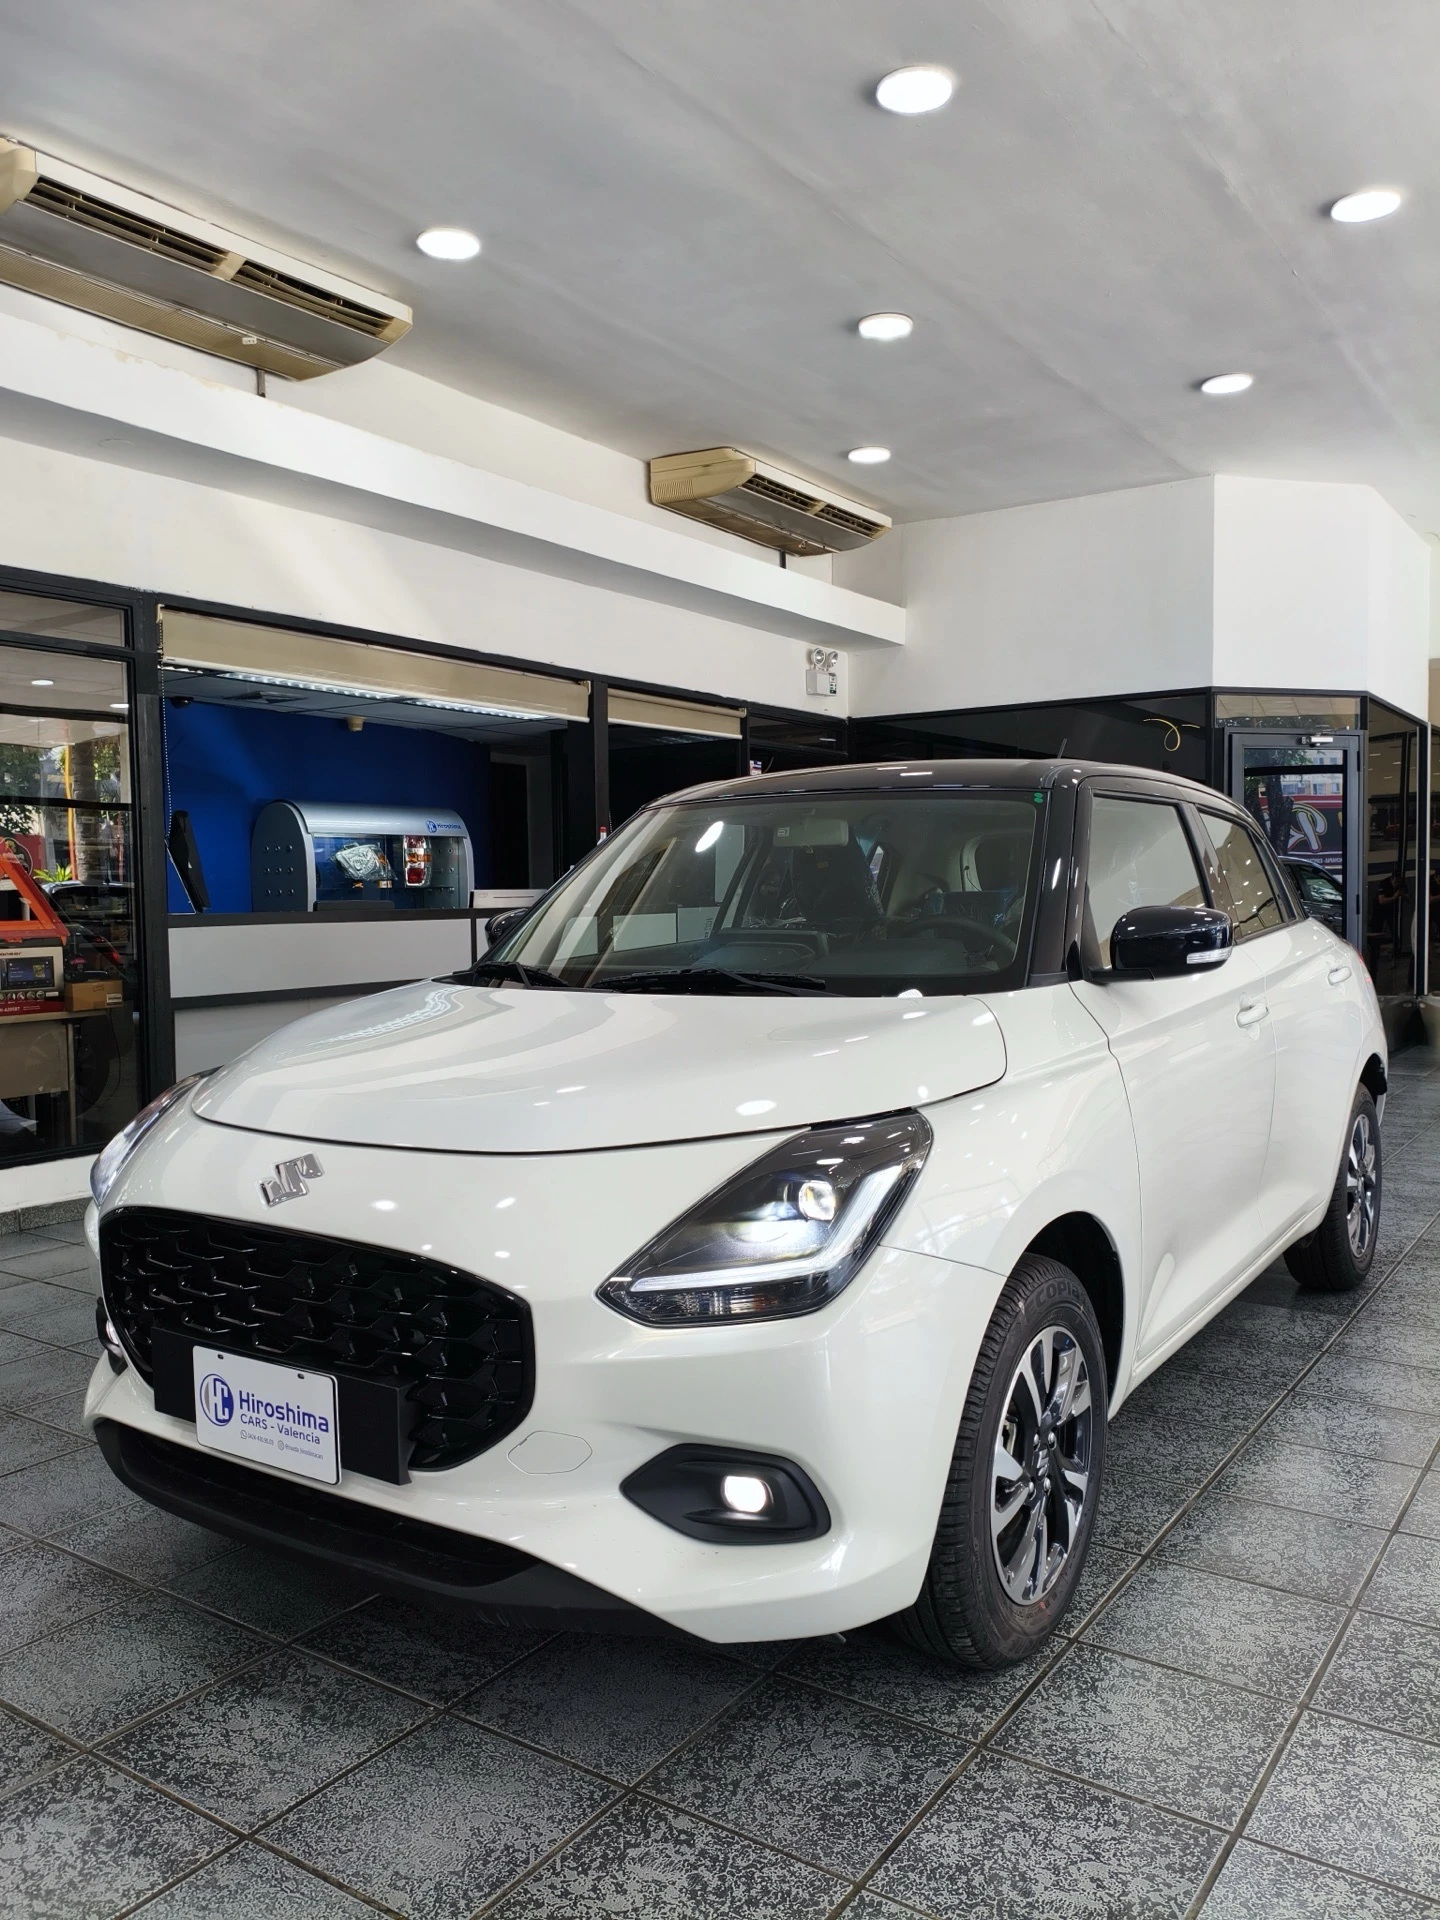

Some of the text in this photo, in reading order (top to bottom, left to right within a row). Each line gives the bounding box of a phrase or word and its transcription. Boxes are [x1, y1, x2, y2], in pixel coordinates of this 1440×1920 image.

[239, 1390, 329, 1433] Hiroshima
[240, 1414, 268, 1430] CARS
[277, 1423, 321, 1445] Valencia
